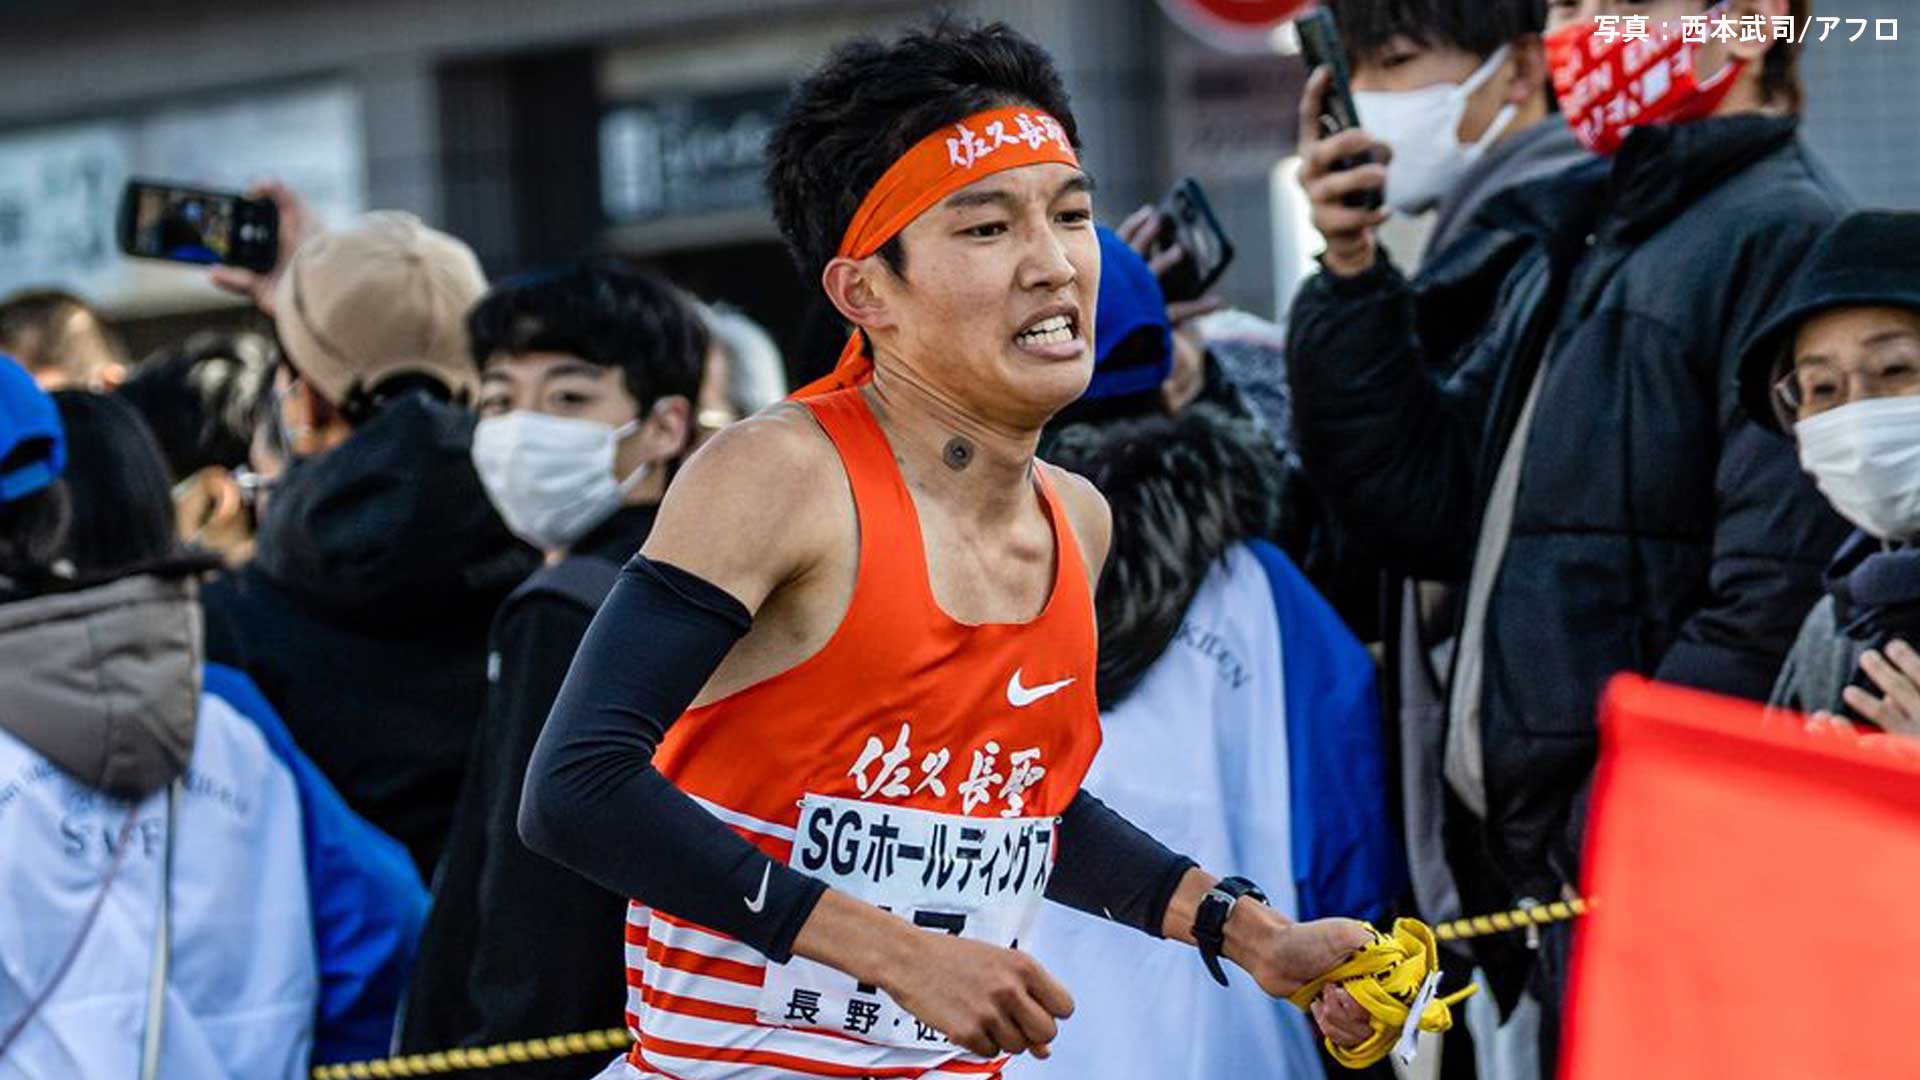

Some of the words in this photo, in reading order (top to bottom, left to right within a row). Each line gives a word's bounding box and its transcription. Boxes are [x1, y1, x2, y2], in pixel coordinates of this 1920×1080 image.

[847, 722, 1046, 818] 佐久長聖
[801, 806, 1051, 896] SGホールディングス
